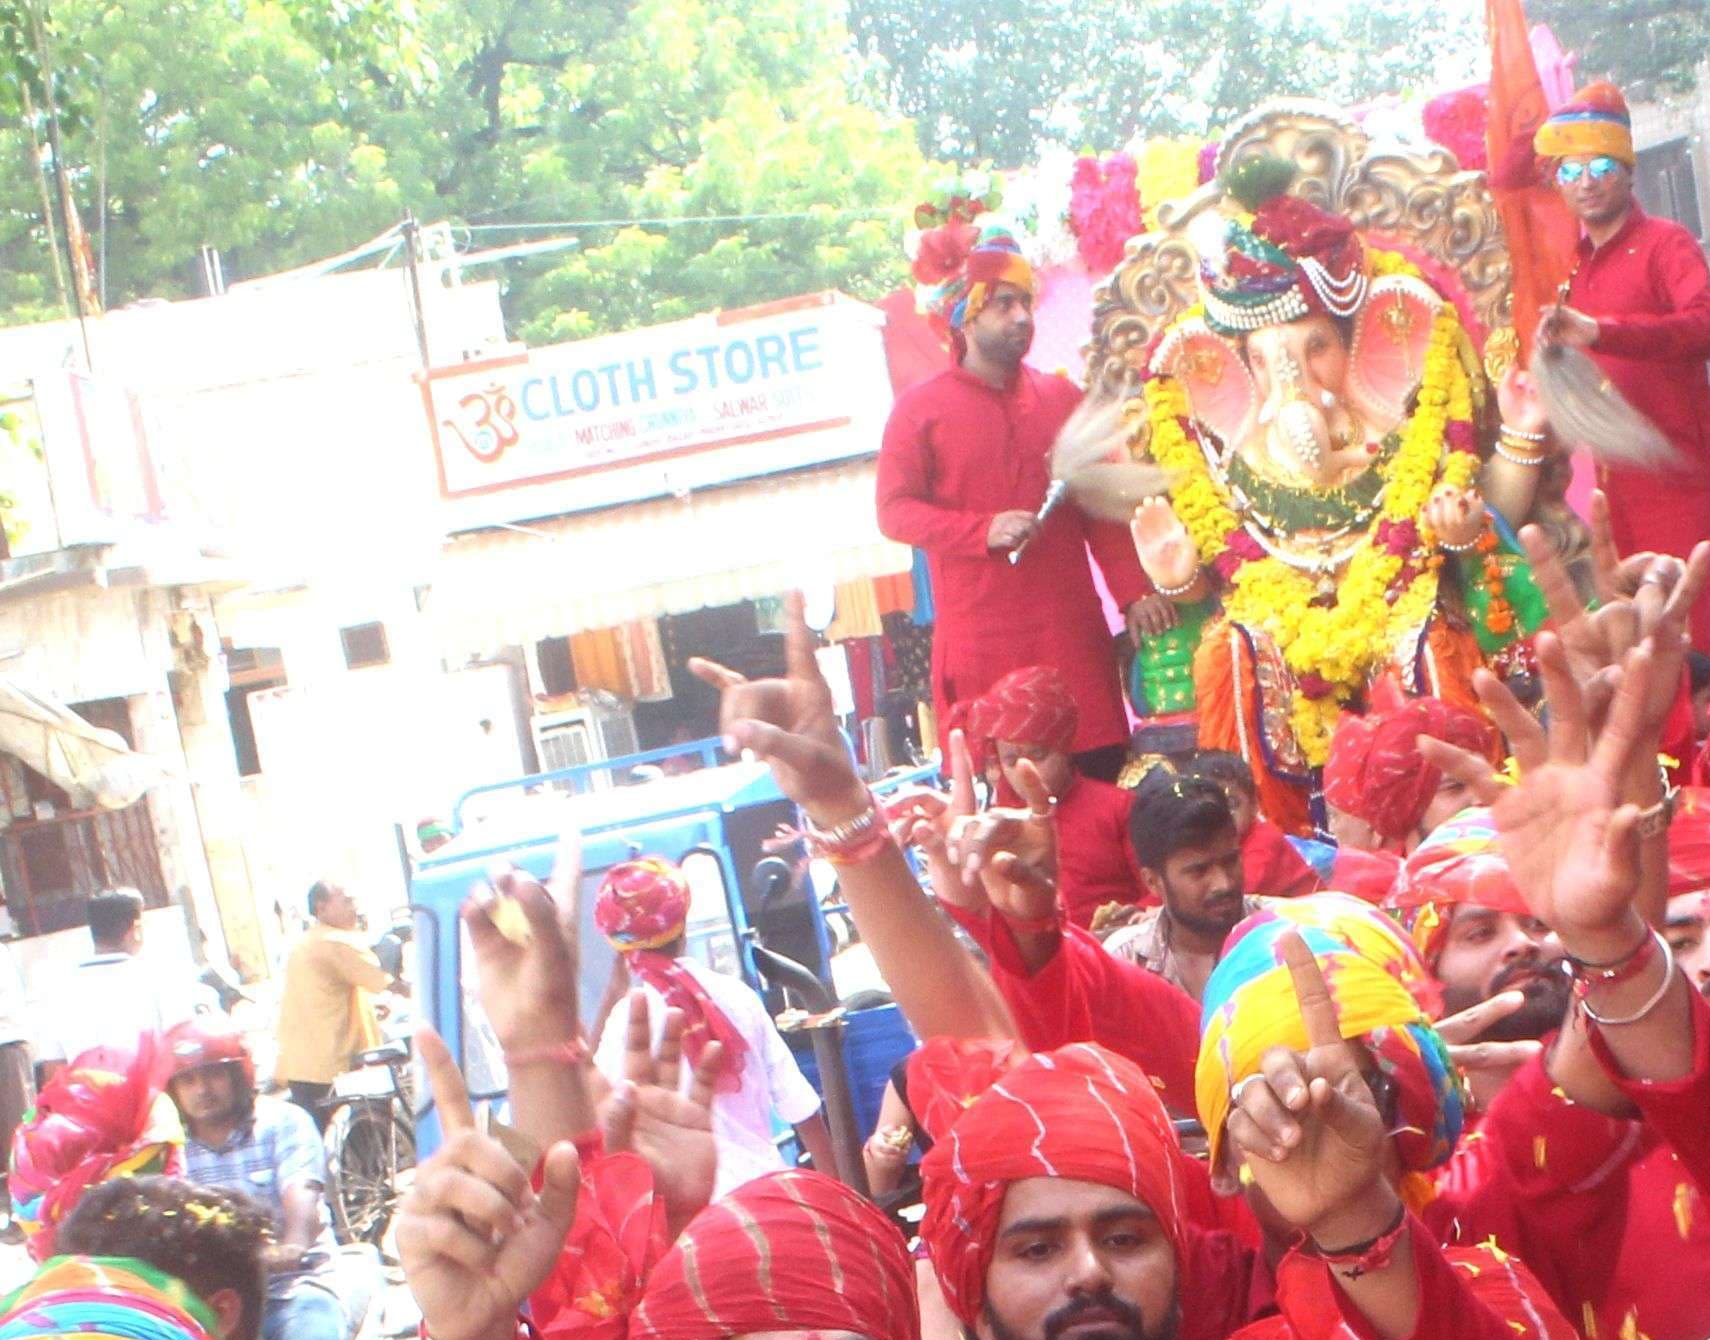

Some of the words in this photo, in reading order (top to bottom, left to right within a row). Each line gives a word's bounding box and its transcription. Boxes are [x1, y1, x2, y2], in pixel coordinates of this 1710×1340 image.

[520, 357, 658, 421] CLOTH
[668, 327, 823, 395] STORE
[574, 419, 638, 448] MATCHING
[713, 393, 769, 420] SALWAR
